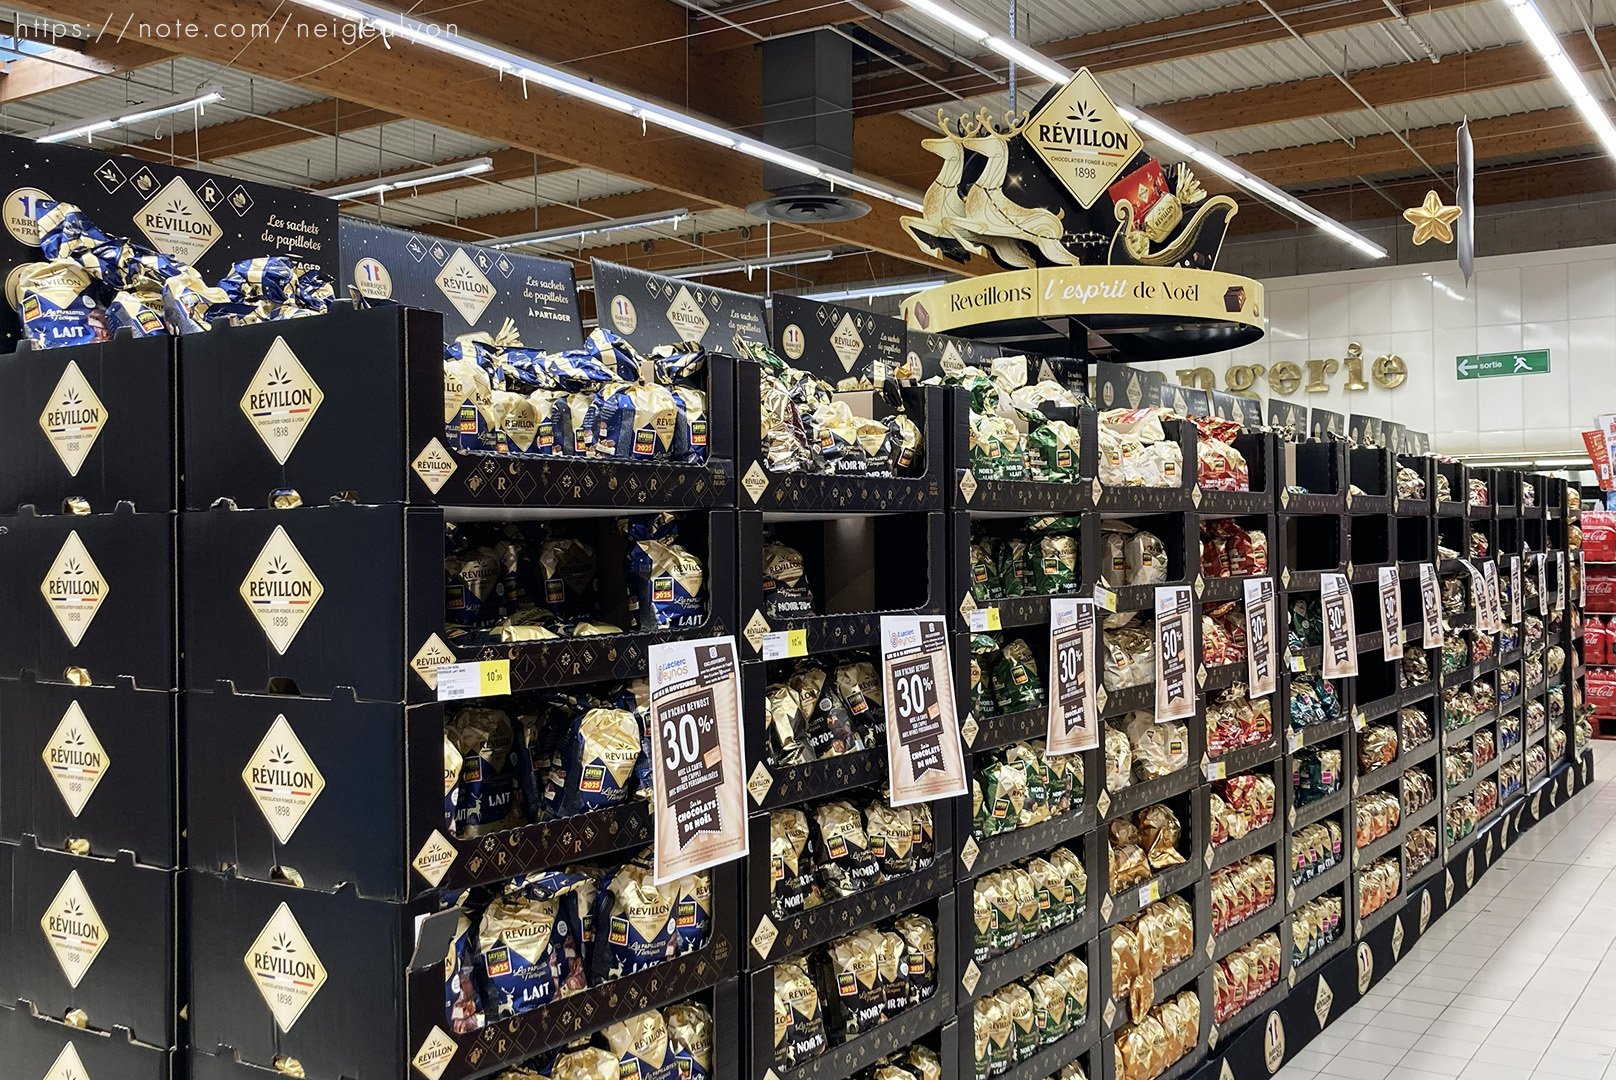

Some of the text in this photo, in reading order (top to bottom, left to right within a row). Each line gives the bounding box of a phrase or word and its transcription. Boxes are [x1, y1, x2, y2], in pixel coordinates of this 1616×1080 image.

[1039, 122, 1128, 150] RÉVILLON
[1074, 167, 1096, 179] 1898
[205, 187, 216, 203] R
[11, 217, 38, 227] FABRI
[145, 213, 212, 236] RÉVILLON
[267, 215, 320, 235] Les sachets
[21, 228, 40, 236] FRAN
[261, 230, 322, 251] de papillotes
[172, 246, 188, 256] 1898
[443, 276, 489, 294] RÉVILLON
[526, 276, 566, 291] Les sachets
[523, 288, 569, 306] de papillotes
[1044, 279, 1128, 304] l'esprit
[1133, 281, 1155, 299] de
[1161, 281, 1199, 302] Noël
[535, 310, 571, 322] PARTAGER
[53, 326, 84, 338] LAIT
[736, 322, 762, 334] papillotes
[1479, 360, 1502, 370] sortie
[250, 389, 312, 410] RÉVILLON
[47, 407, 99, 427] RÉVILLON
[273, 426, 289, 438] 1898
[66, 441, 80, 452] 1898
[417, 460, 452, 470] RÉVILLON
[838, 460, 857, 470] NOIR
[498, 477, 506, 490] R
[650, 478, 657, 490] R
[573, 486, 581, 498] R
[49, 578, 100, 596] RÉVILLON
[250, 578, 312, 597] RÉVILLON
[655, 591, 672, 600] 2025
[778, 602, 798, 611] NOIR
[67, 612, 81, 623] 1898
[272, 616, 289, 628] 1898
[678, 614, 702, 626] LAIT
[416, 656, 451, 666] RÉVILLON
[572, 662, 580, 675] R
[50, 746, 100, 768] RÉVILLON
[252, 767, 314, 789] RÉVILLON
[68, 782, 82, 793] 1898
[584, 780, 600, 789] 2025
[488, 792, 511, 806] LAIT
[274, 805, 291, 817] 1898
[678, 800, 716, 824] CHOCOLATS
[684, 813, 712, 833] DE NOËL
[574, 841, 582, 852] R
[418, 850, 453, 865] RÉVILLON
[498, 852, 506, 864] R
[852, 866, 873, 879] NOIR
[678, 916, 694, 924] 2025
[49, 916, 100, 940] RÉVILLON
[611, 933, 625, 942] 2025
[67, 952, 80, 964] 1898
[254, 952, 316, 979] RÉVILLON
[490, 962, 509, 974] 2025
[523, 982, 550, 1002] LAIT
[276, 994, 293, 1006] 1898
[796, 1039, 816, 1054] NOIR
[418, 1045, 453, 1061] RÉVILLON
